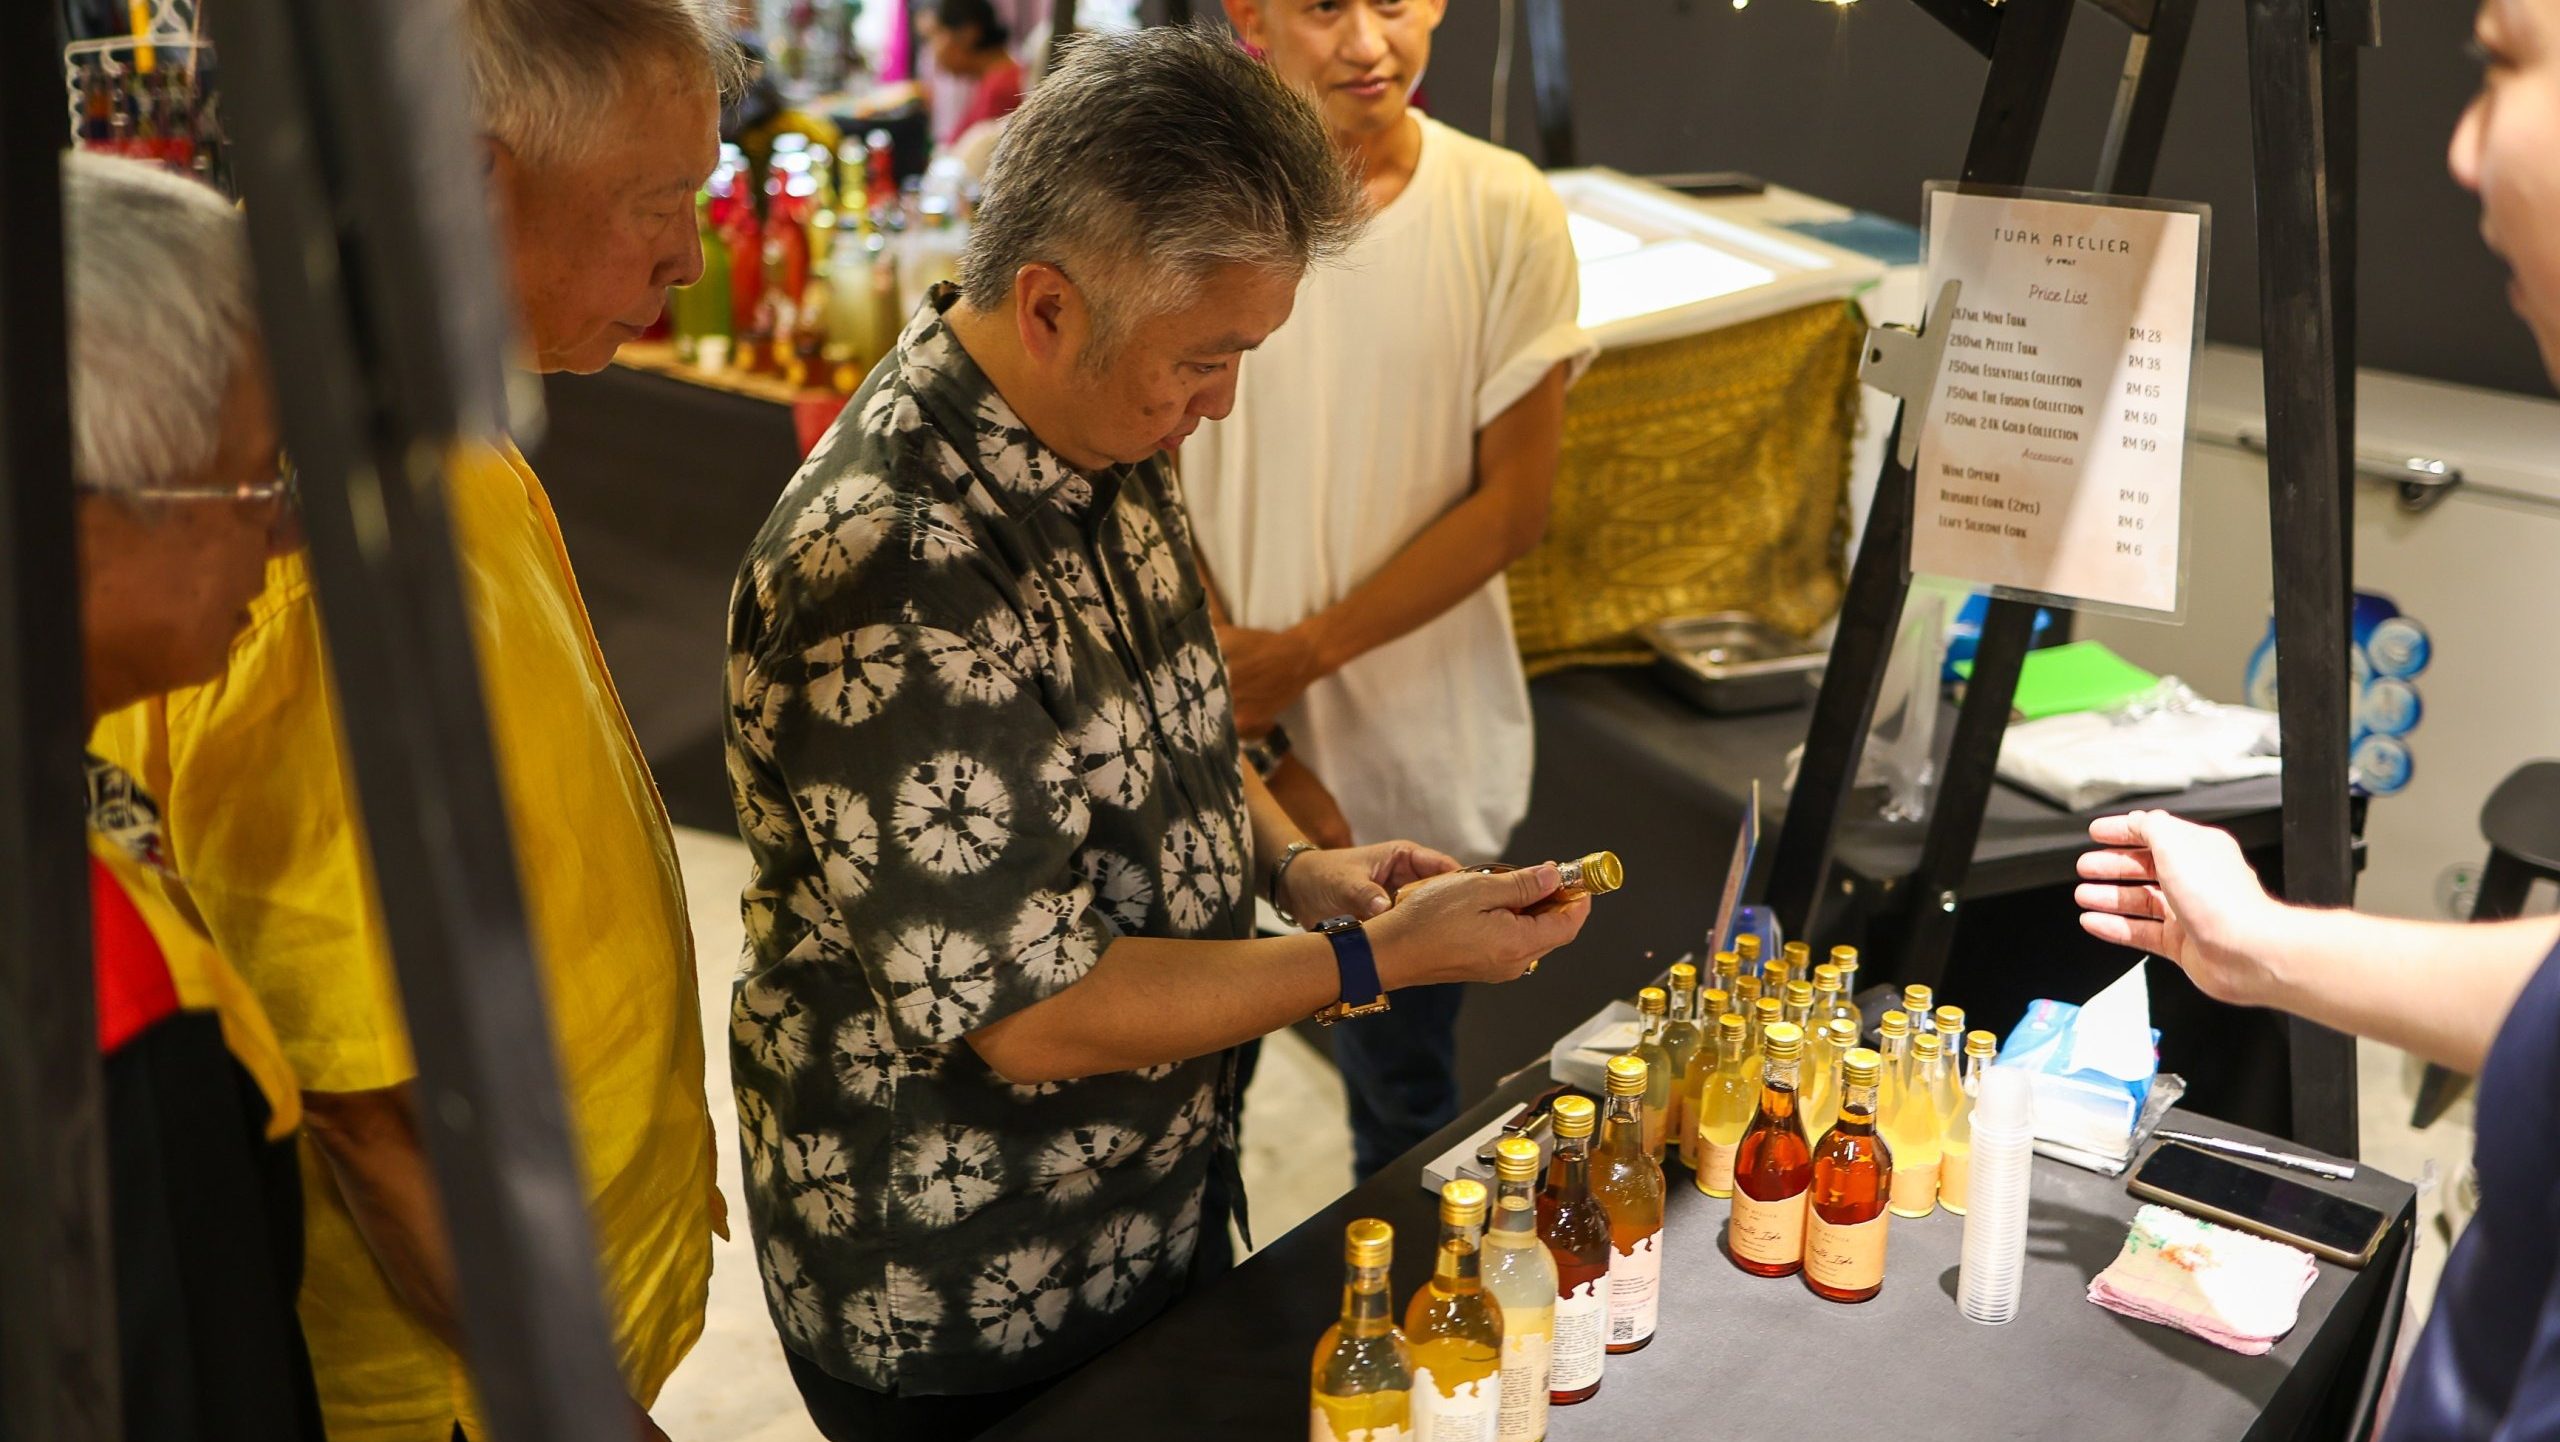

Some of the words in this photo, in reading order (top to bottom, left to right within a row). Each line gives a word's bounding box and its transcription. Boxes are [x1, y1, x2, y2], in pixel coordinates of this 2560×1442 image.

[1994, 228, 2040, 244] TUAK
[2053, 234, 2130, 253] ATELIER
[2028, 284, 2061, 301] Price
[2064, 288, 2088, 305] List
[2129, 327, 2144, 341] RM
[2147, 329, 2161, 343] 28
[1985, 337, 2014, 353] PETITE
[2128, 354, 2143, 368] RM
[2146, 357, 2161, 371] 38
[1983, 363, 2029, 382] ESSENTIALS
[2031, 370, 2082, 388] COLLECTION
[2126, 382, 2141, 395] RM
[2144, 384, 2160, 398] 65
[1982, 390, 1997, 405] THE
[2000, 392, 2030, 408] FUSION
[2033, 397, 2084, 415] COLLECTION
[2124, 409, 2139, 422] RM
[2002, 419, 2026, 434] GOLD
[2028, 423, 2079, 441] COLLECTION
[2122, 436, 2137, 449] RM
[2140, 438, 2156, 452] 99
[2021, 448, 2074, 465] Accessories
[1941, 463, 1964, 478] WINE
[1967, 467, 2000, 483] OPENER
[2120, 488, 2134, 502] RM
[2138, 491, 2149, 504] 10
[2007, 498, 2041, 516] (2PCS)
[2118, 515, 2133, 528] RM
[2136, 518, 2144, 530] 6
[2116, 541, 2131, 554] RM
[2134, 544, 2142, 556] 6
